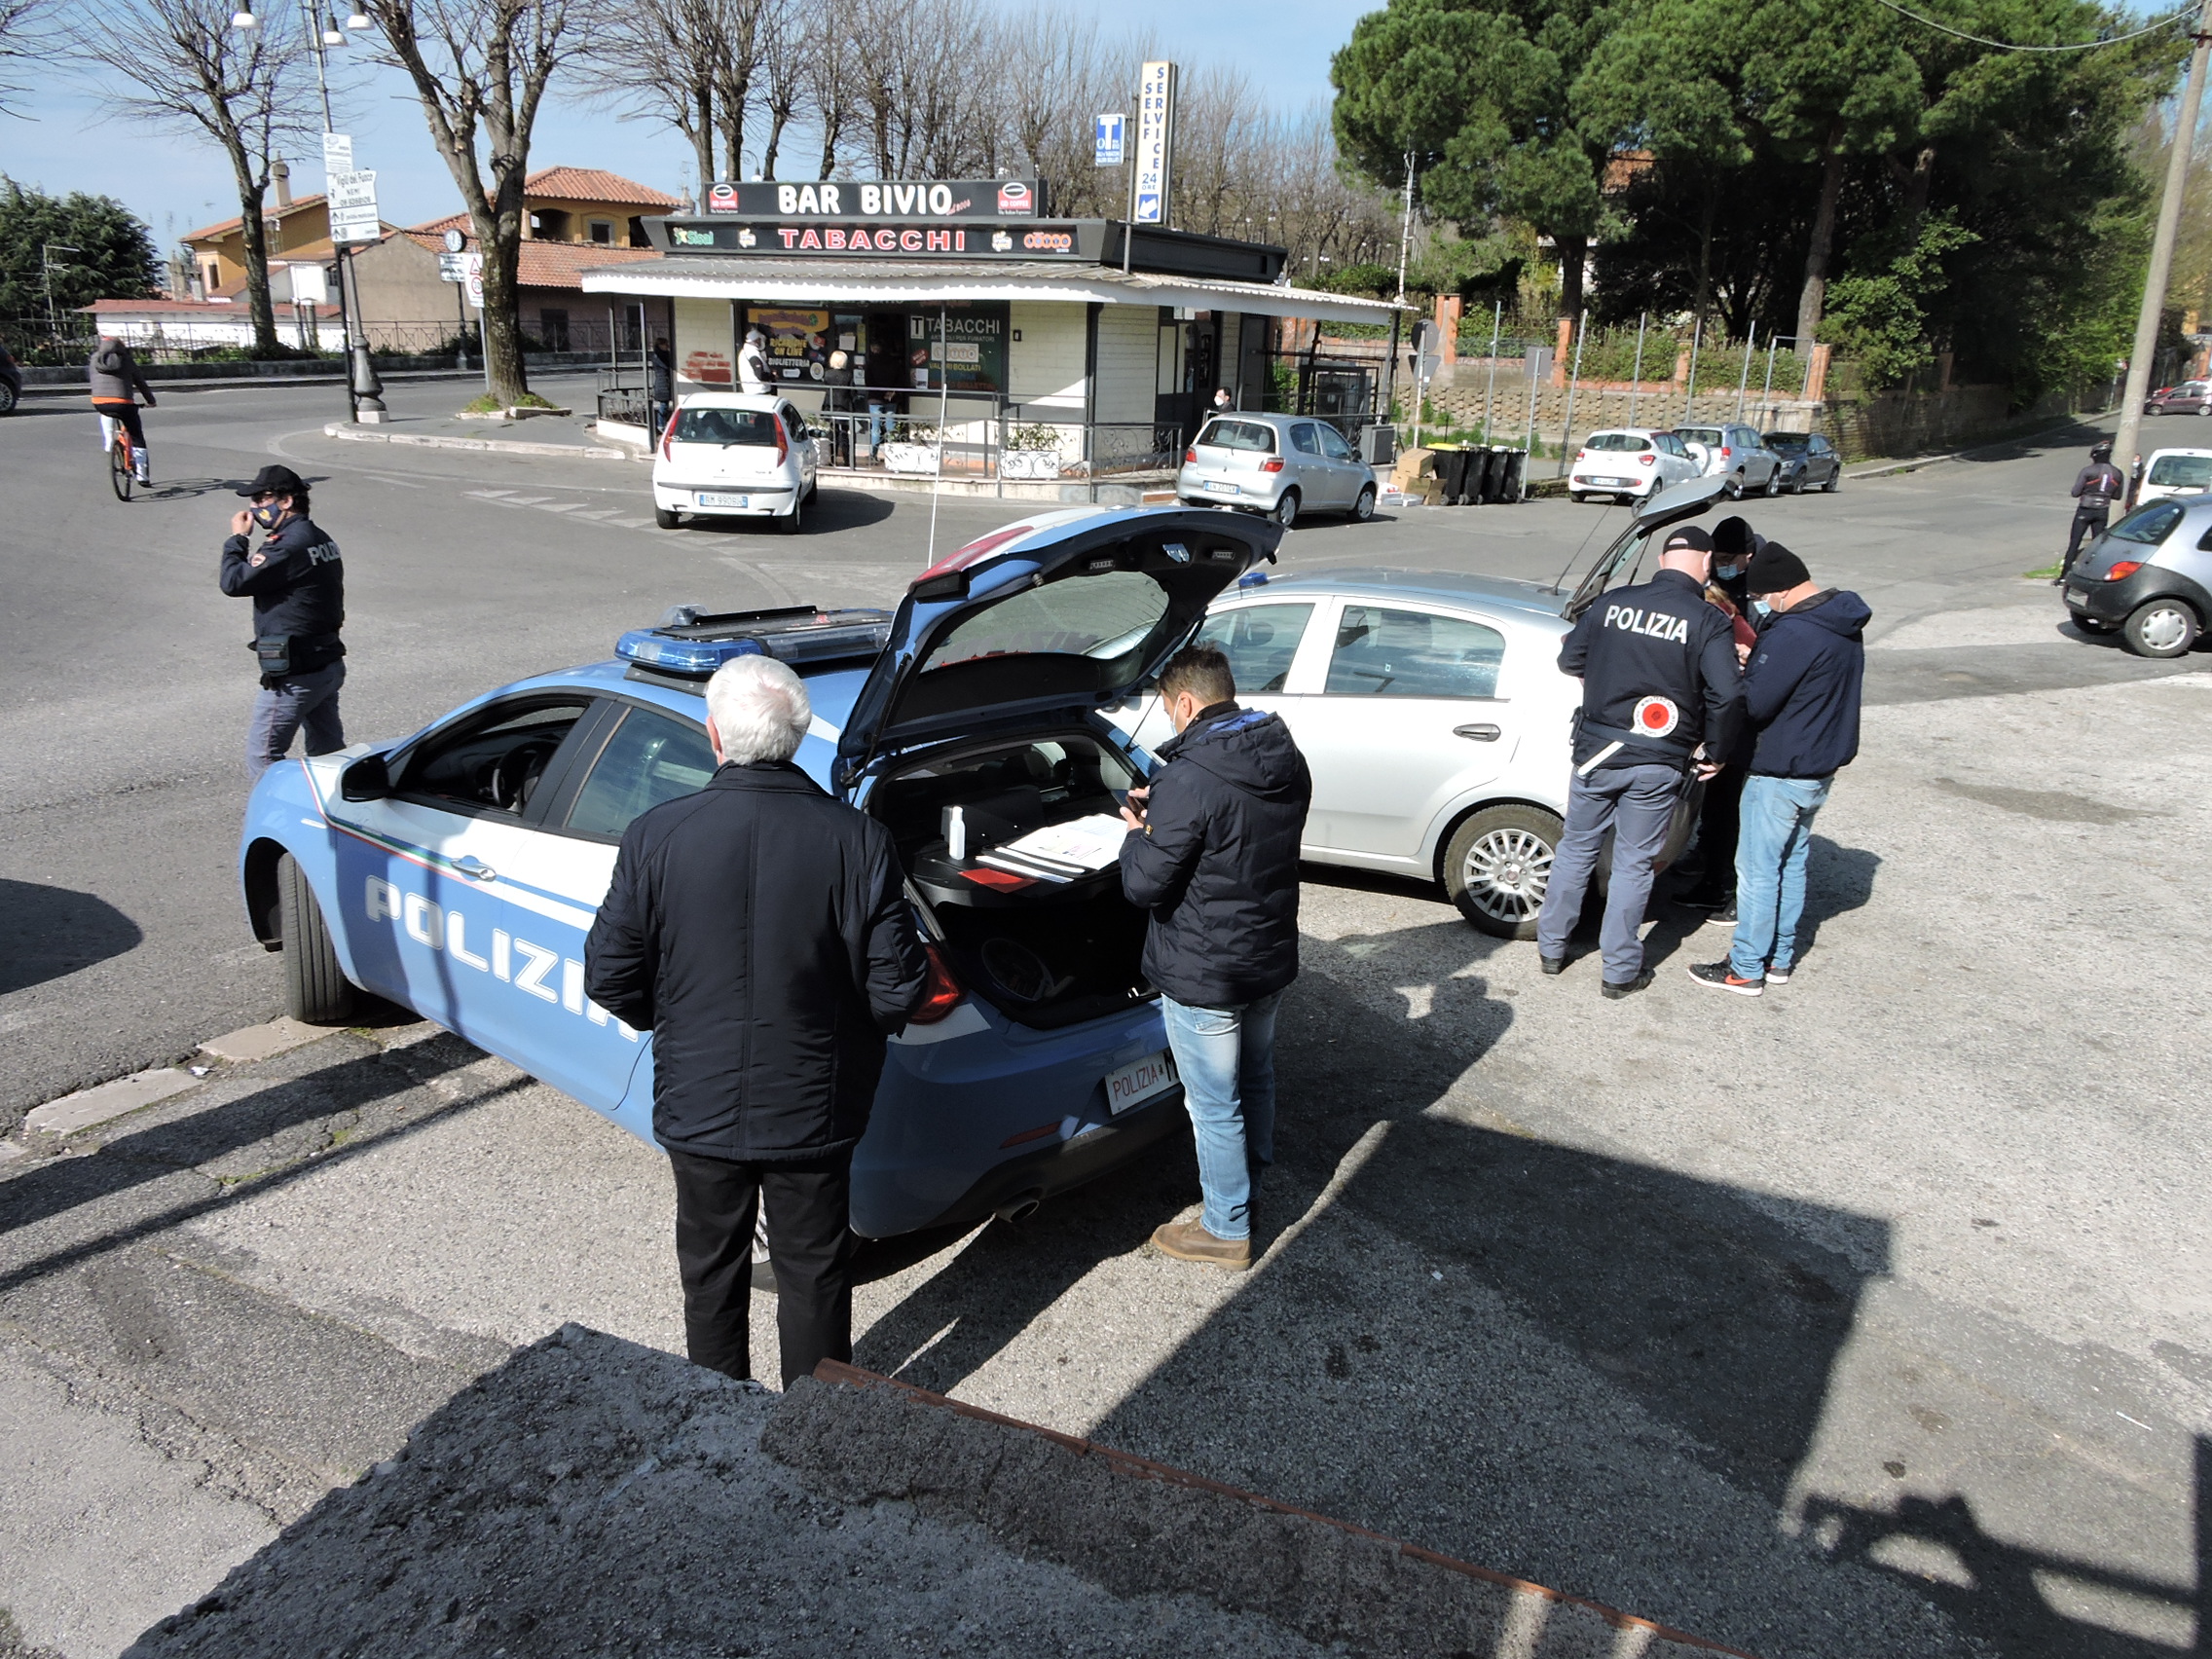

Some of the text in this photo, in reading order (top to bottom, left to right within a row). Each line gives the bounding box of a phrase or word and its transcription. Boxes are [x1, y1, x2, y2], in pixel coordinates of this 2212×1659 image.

[1143, 83, 1152, 139] SELF
[1153, 67, 1164, 169] SERVICE
[1142, 173, 1157, 185] 24
[779, 184, 952, 215] BAR BIVIO
[686, 230, 714, 245] Sisal
[778, 229, 965, 251] TABACCHI
[926, 317, 1000, 334] TABACCHI
[1604, 605, 1688, 645] POLIZIA
[365, 875, 639, 1043] POLIZI
[1113, 1063, 1160, 1102] POLIZIA
